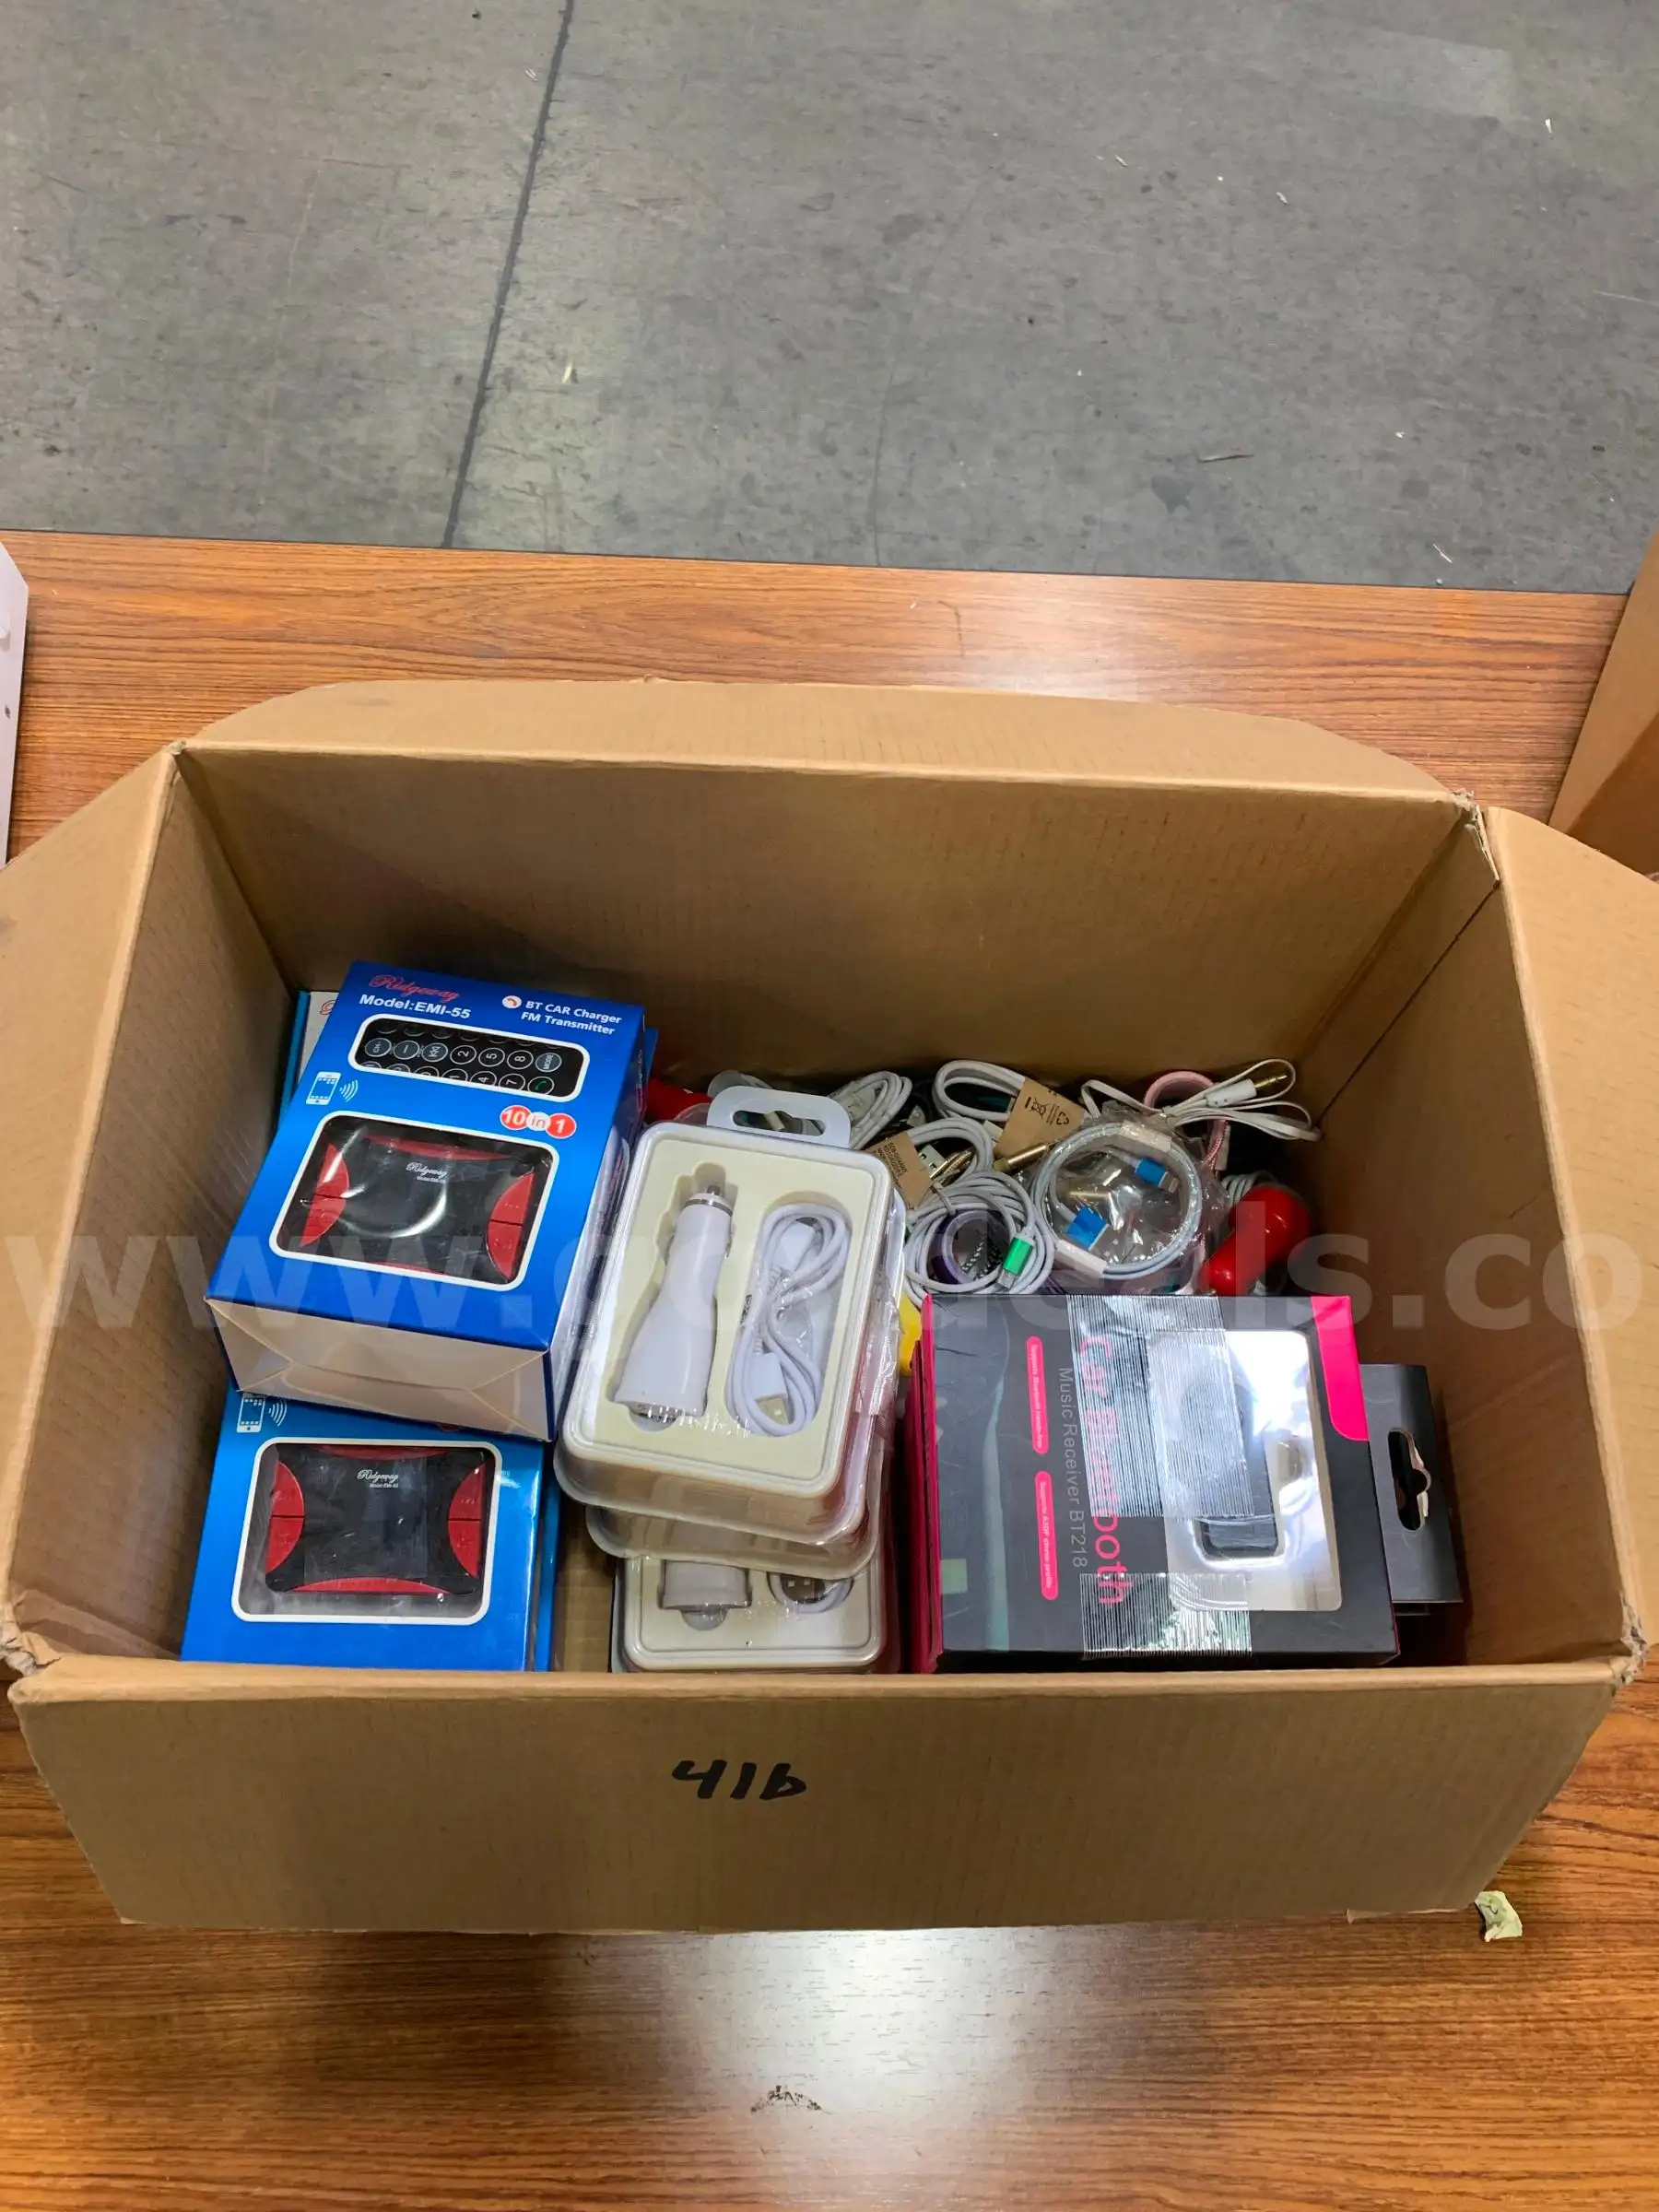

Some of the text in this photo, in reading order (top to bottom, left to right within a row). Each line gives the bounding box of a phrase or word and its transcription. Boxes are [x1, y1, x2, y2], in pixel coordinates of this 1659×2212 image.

[369, 974, 459, 1003] Ridgeway
[359, 994, 472, 1019] Model:EMI-55
[525, 1000, 622, 1025] BT CAR Charger
[521, 1012, 615, 1035] FM Transmitter
[543, 1054, 555, 1070] MODE
[504, 1109, 566, 1134] 10 in 1
[1058, 1368, 1088, 1568] Music Receiver BT218
